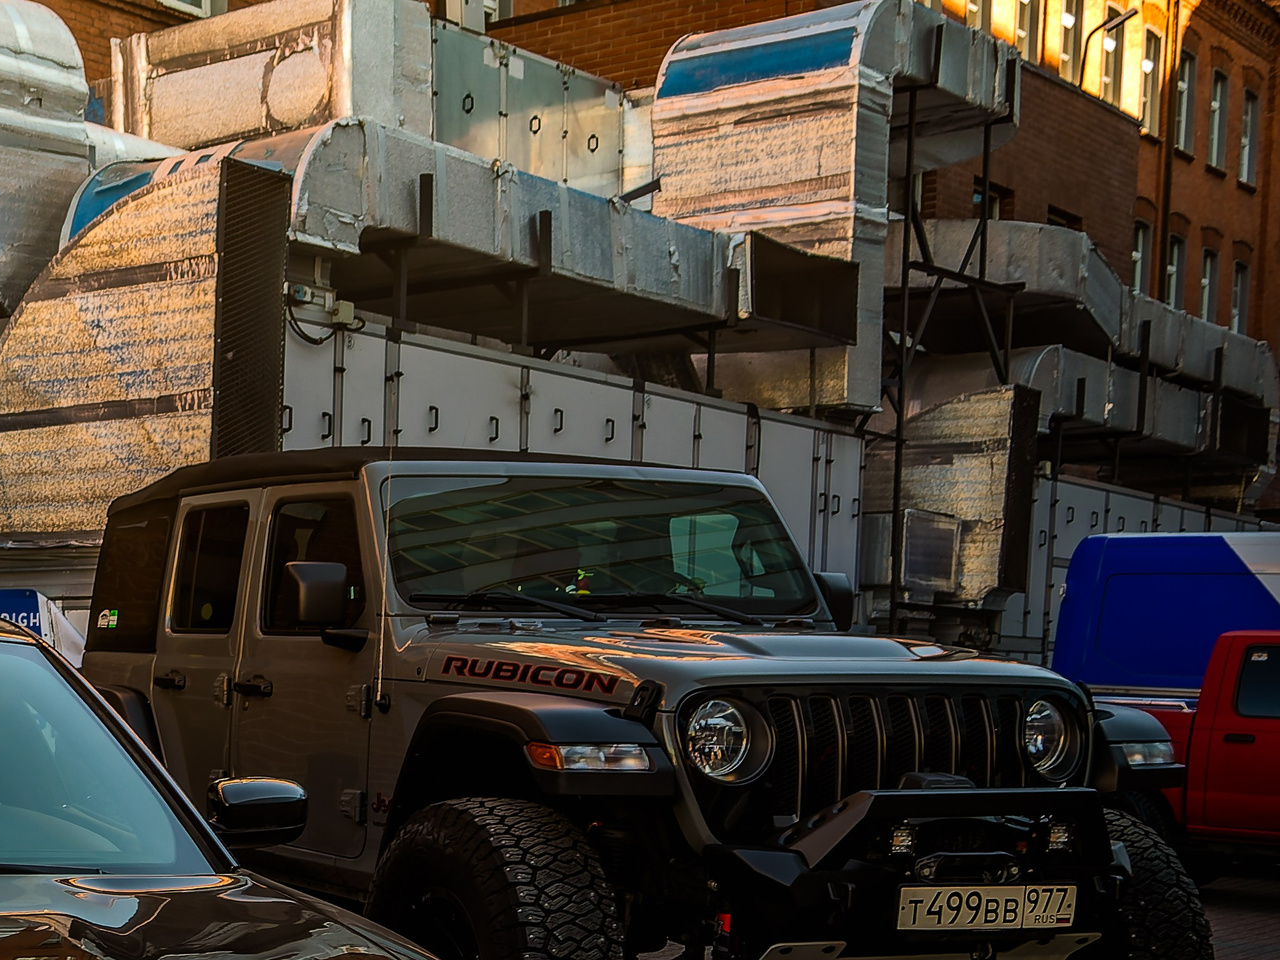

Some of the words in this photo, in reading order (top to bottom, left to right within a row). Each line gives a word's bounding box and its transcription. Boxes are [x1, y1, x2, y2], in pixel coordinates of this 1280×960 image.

[441, 655, 620, 694] RUBICON
[1026, 888, 1069, 914] 977
[1034, 914, 1055, 924] RUS
